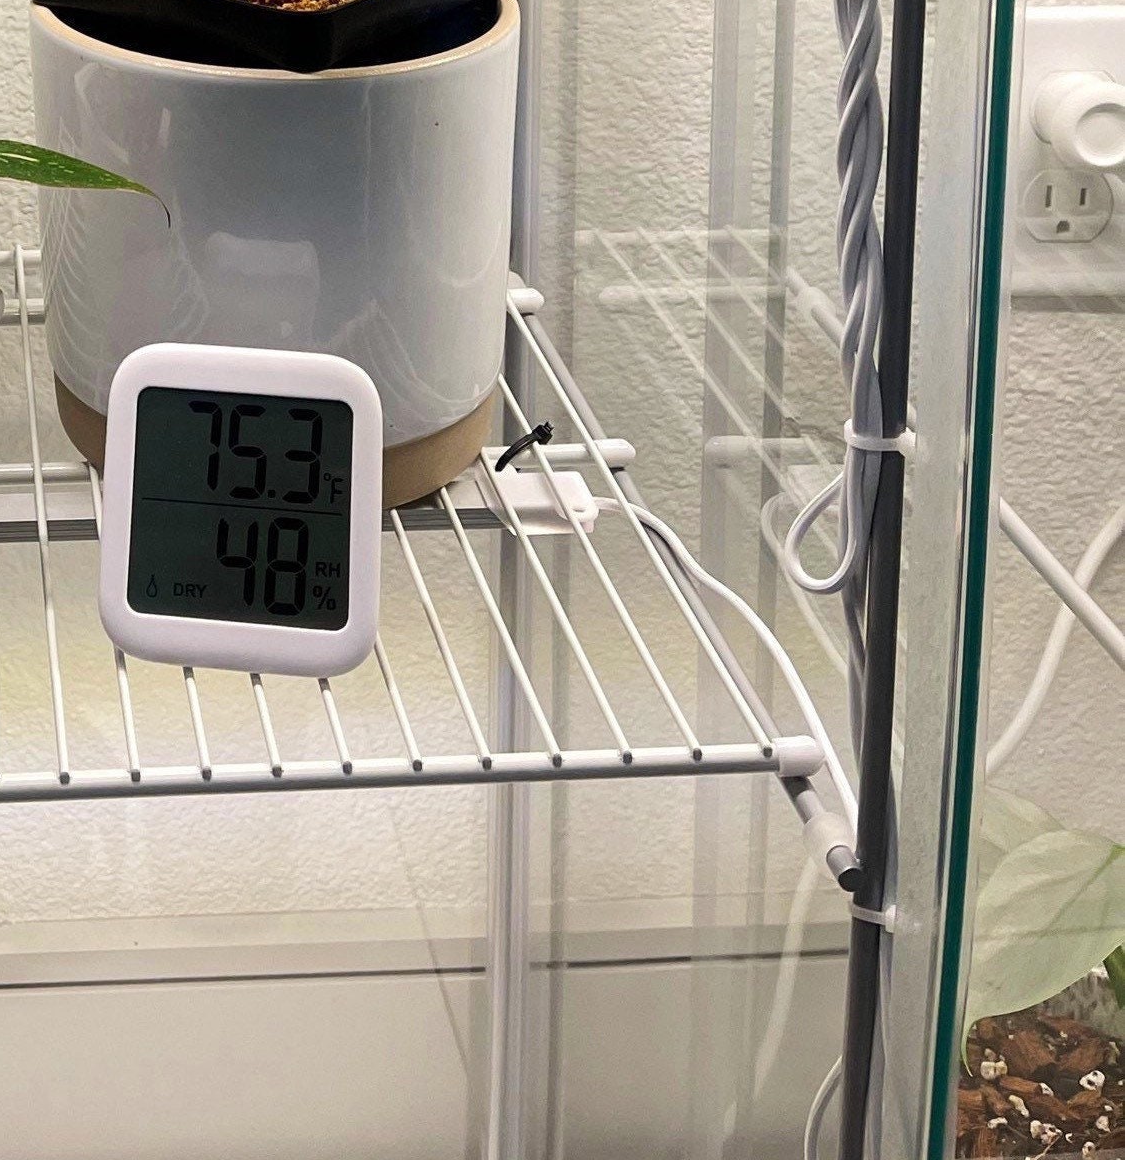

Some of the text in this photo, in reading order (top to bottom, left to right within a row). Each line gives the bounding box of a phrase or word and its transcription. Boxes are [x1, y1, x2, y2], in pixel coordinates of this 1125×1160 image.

[188, 400, 323, 504] 75.3
[216, 516, 309, 616] 48
[314, 560, 342, 579] RH
[173, 582, 208, 599] DRY
[312, 584, 337, 611] %
